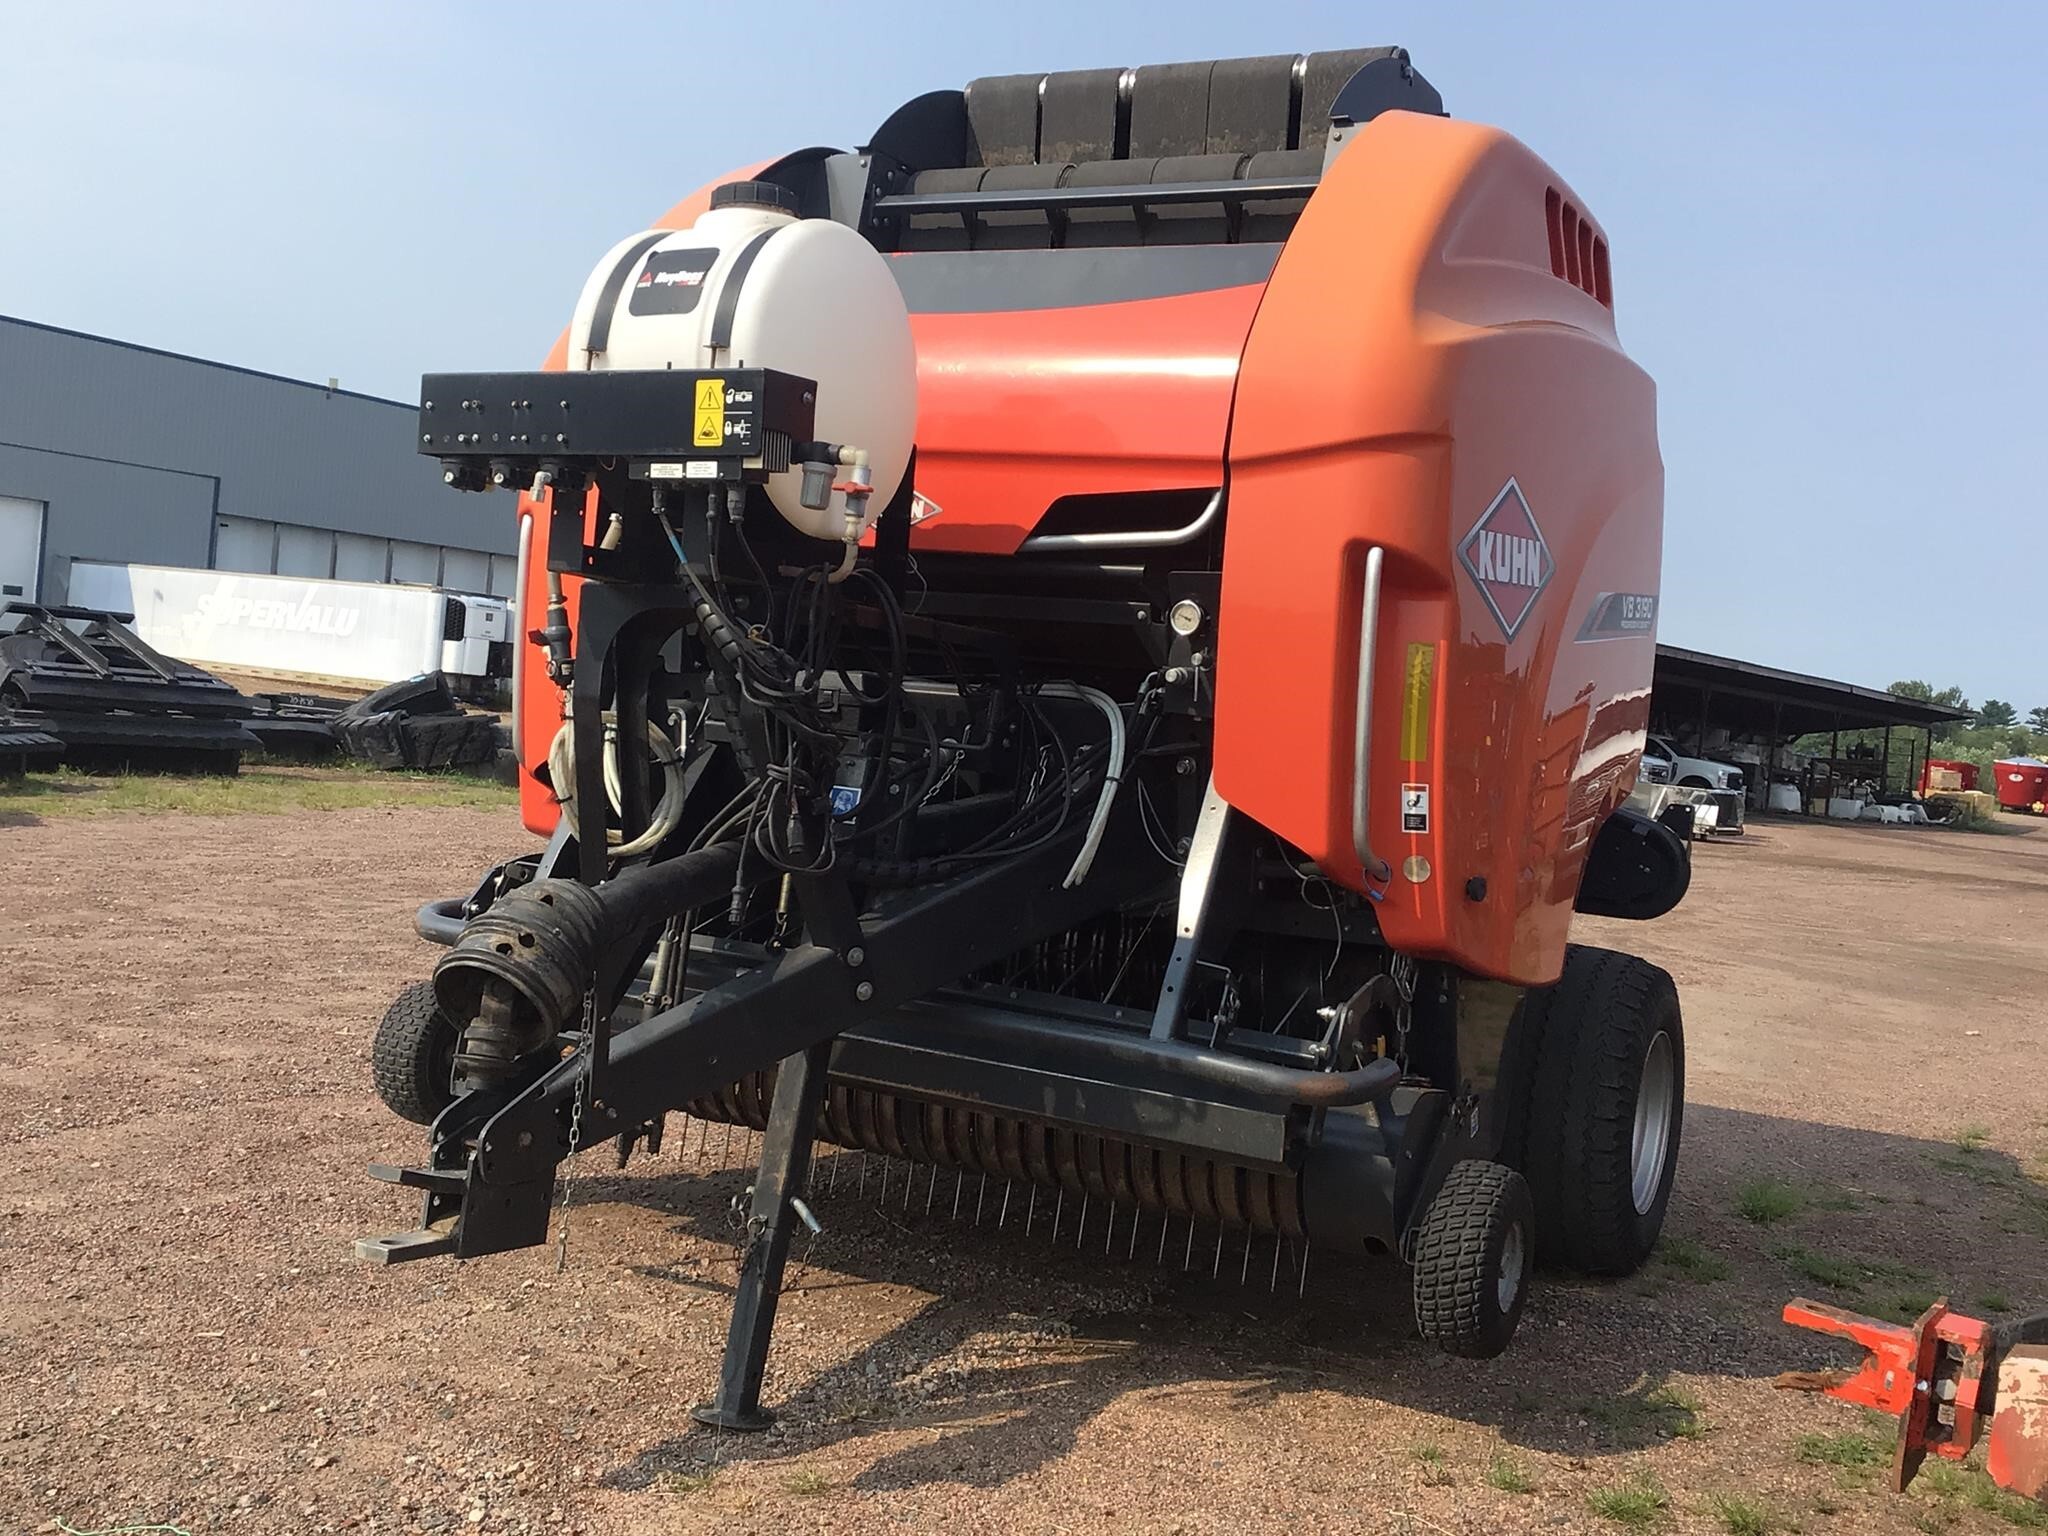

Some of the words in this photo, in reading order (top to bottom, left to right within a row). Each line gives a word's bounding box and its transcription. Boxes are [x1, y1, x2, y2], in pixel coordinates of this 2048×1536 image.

[1479, 529, 1541, 588] KUHN
[197, 578, 361, 638] SUPERVALU
[1622, 595, 1635, 618] VB
[1635, 596, 1653, 618] 3190
